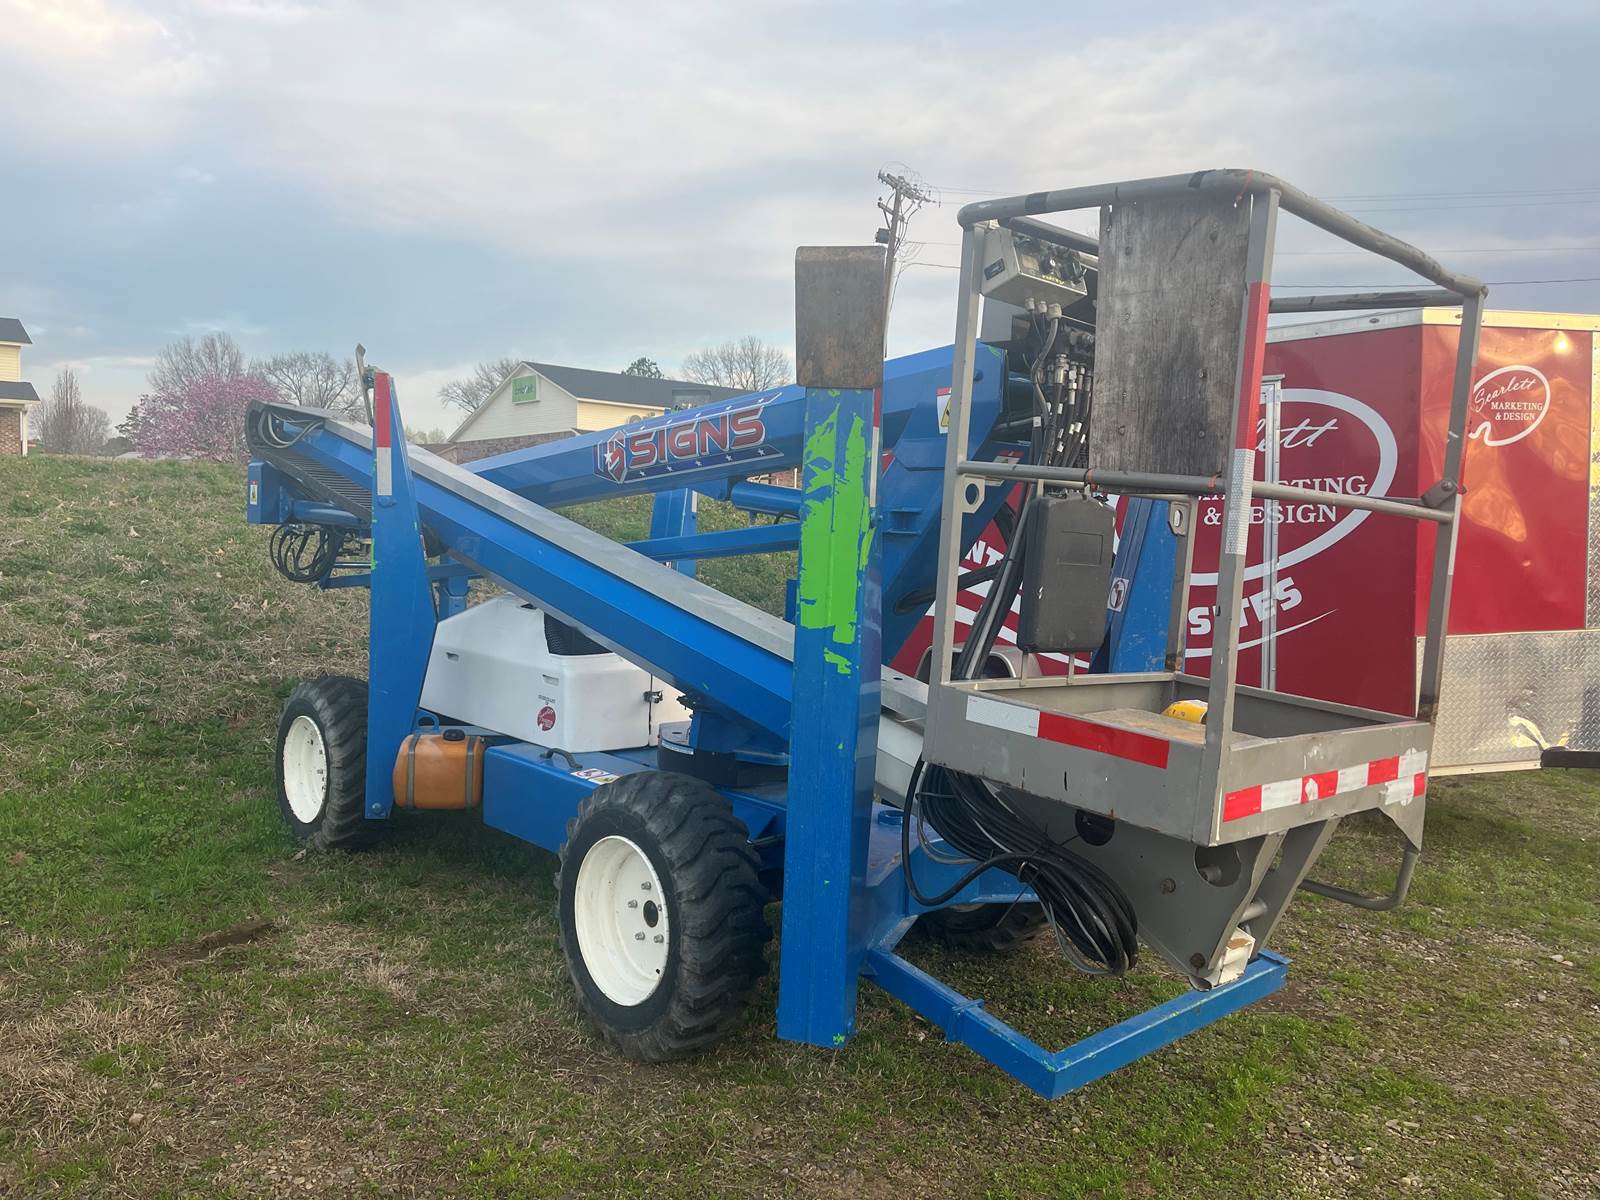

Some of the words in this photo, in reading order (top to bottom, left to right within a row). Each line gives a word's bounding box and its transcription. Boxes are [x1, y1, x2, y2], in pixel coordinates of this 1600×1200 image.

[1474, 376, 1537, 413] Scarlett
[1490, 401, 1544, 411] MARKETING
[1495, 411, 1502, 421] &
[1503, 412, 1536, 421] DESIGN
[629, 405, 766, 470] SIGNS
[1203, 507, 1221, 526] &
[1249, 503, 1337, 525] ESIGN
